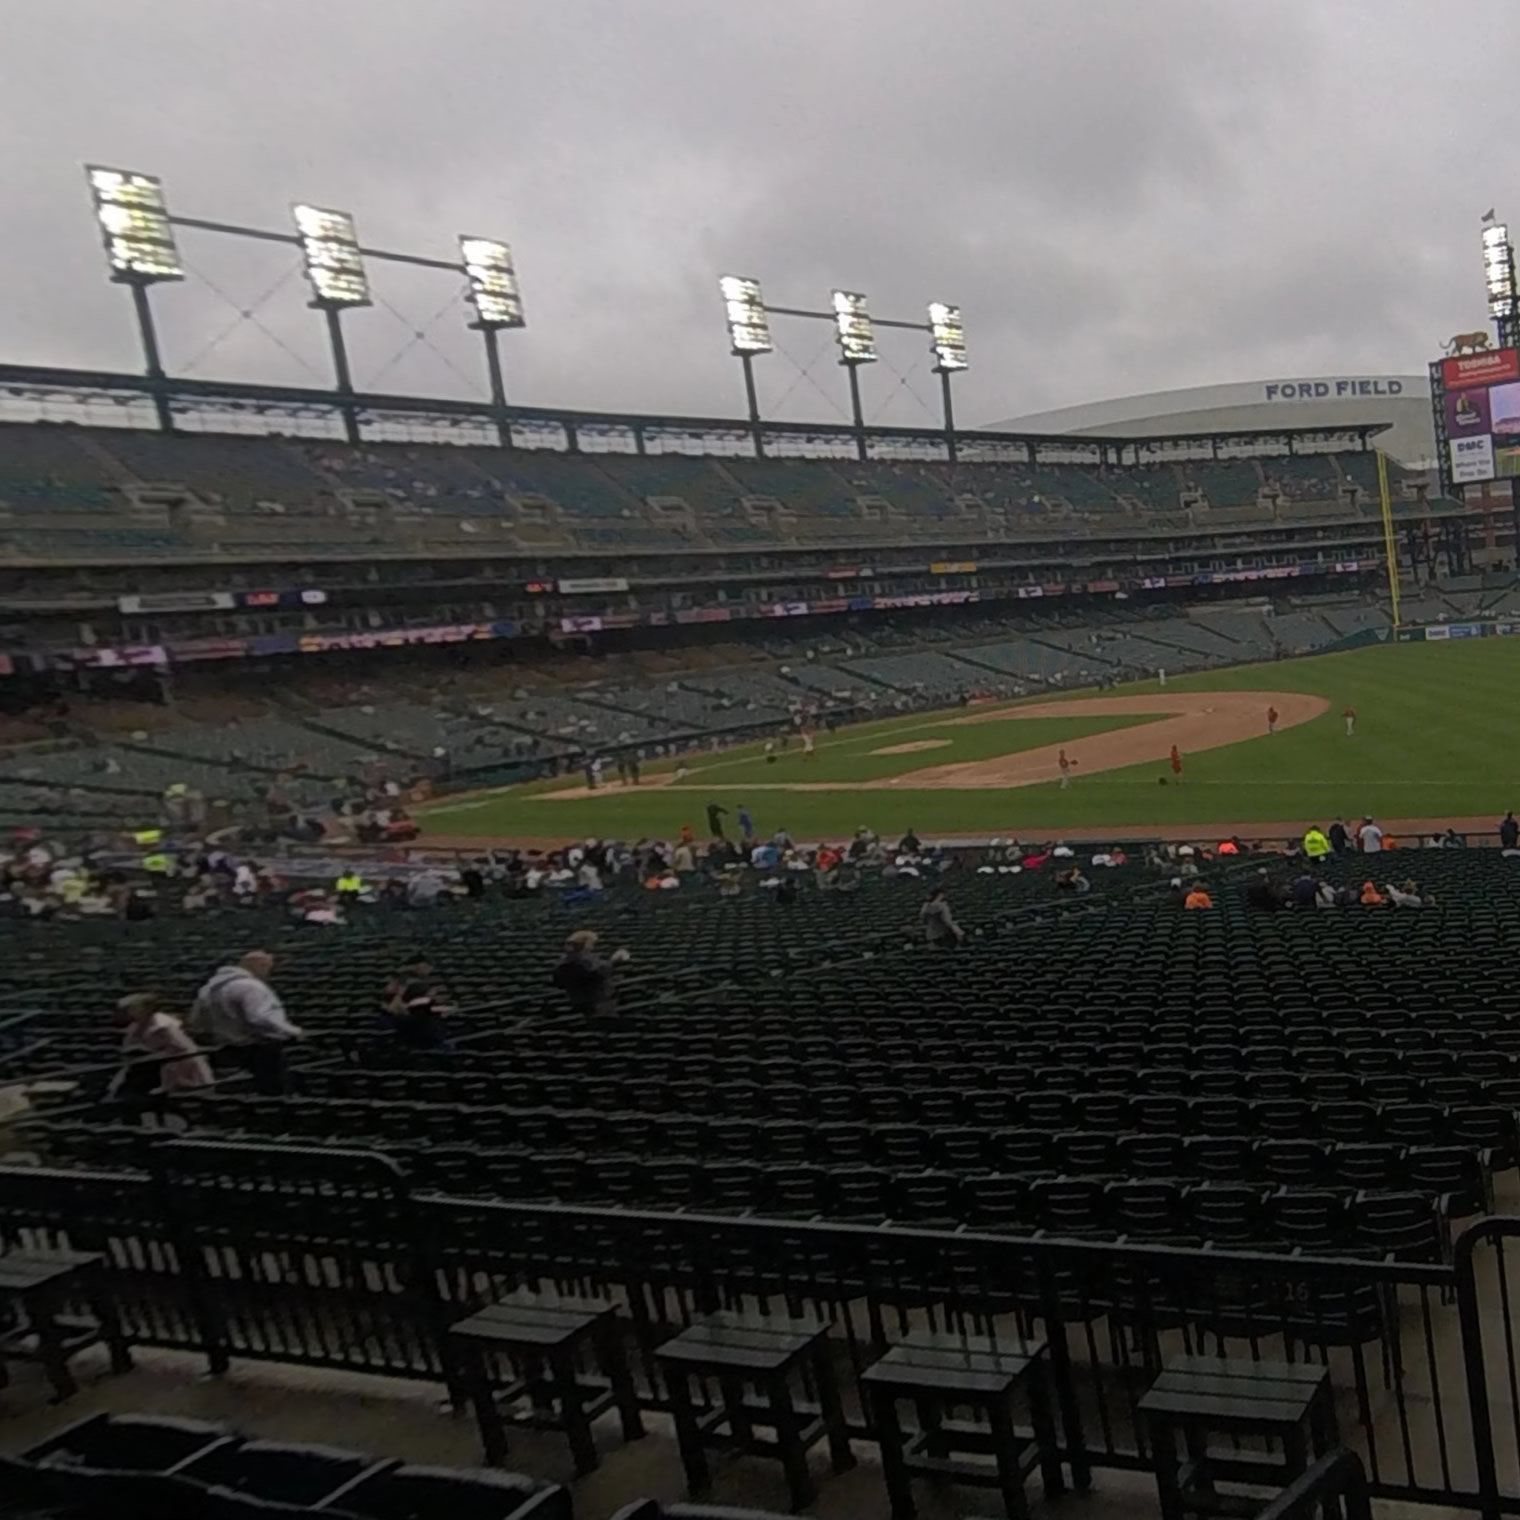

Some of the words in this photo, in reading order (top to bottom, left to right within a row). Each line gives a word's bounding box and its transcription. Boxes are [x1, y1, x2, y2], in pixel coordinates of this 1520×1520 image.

[1265, 382, 1330, 400] FORD
[1335, 380, 1403, 396] FIELD
[1457, 439, 1485, 452] DMC
